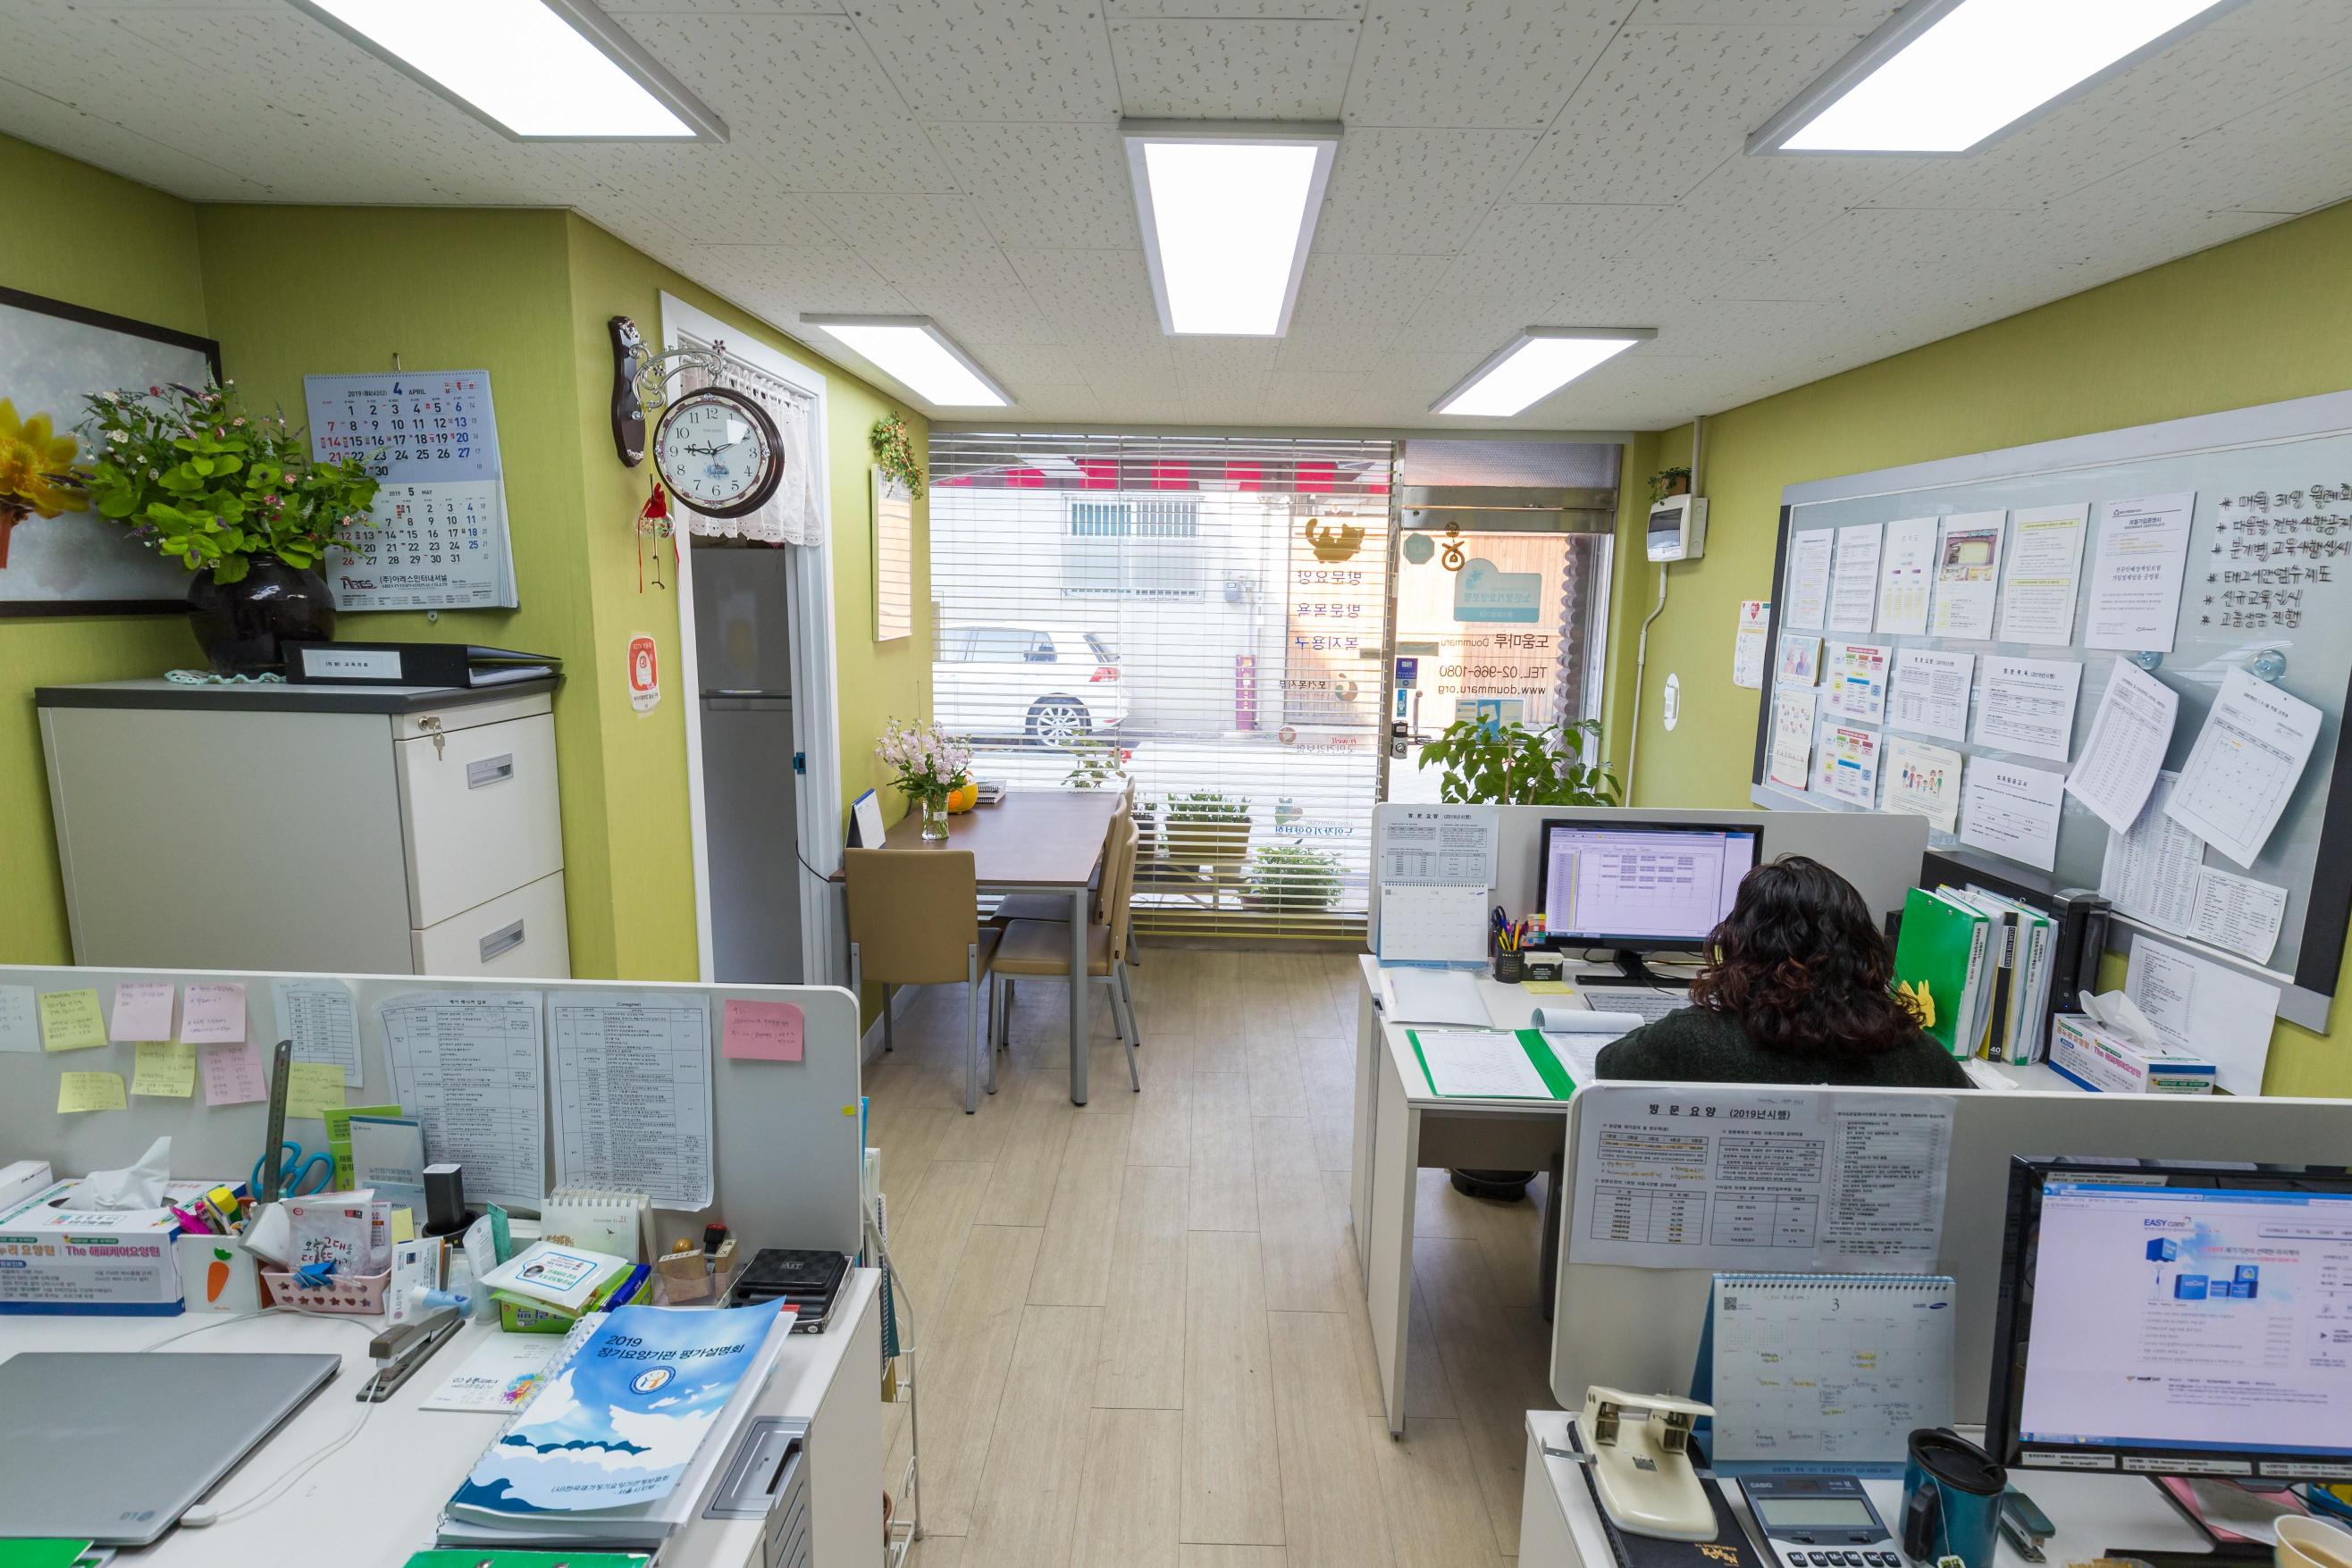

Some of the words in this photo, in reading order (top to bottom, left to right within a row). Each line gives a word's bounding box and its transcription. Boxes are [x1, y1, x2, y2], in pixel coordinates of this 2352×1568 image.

[393, 382, 402, 396] 4
[349, 406, 353, 415] 1
[370, 406, 377, 415] 2
[391, 405, 399, 415] 3
[413, 404, 421, 414] 4
[434, 403, 441, 413] 5
[455, 402, 463, 412] 6
[706, 407, 718, 419] 12
[690, 413, 699, 423] 11
[328, 422, 335, 432] 7
[350, 421, 357, 431] 8
[372, 421, 379, 431] 9
[391, 420, 404, 430] 10
[413, 419, 424, 429] 11
[434, 418, 447, 429] 12
[455, 417, 467, 427] 13
[676, 428, 690, 439] 10
[327, 437, 341, 448] 14
[349, 436, 363, 447] 15
[372, 436, 384, 446] 16
[393, 435, 406, 445] 17
[415, 434, 427, 444] 18
[436, 433, 449, 444] 19
[456, 432, 469, 443] 20
[329, 452, 341, 462] 21
[350, 451, 365, 462] 22
[395, 450, 408, 460] 24
[416, 449, 430, 459] 25
[437, 449, 450, 458] 26
[458, 448, 471, 457] 27
[670, 446, 678, 457] 9
[749, 448, 758, 458] 3
[375, 465, 389, 476] 30
[676, 465, 685, 475] 8
[743, 465, 752, 476] 4
[693, 480, 701, 491] 7
[711, 485, 720, 496] 6
[731, 481, 740, 491] 5
[407, 488, 415, 496] 5
[2239, 491, 2270, 513] 매월
[406, 505, 411, 514] 1
[427, 504, 433, 513] 2
[447, 503, 453, 512] 3
[467, 502, 474, 511] 4
[385, 518, 391, 527] 7
[407, 517, 414, 526] 8
[428, 516, 434, 525] 9
[447, 516, 458, 524] 10
[466, 516, 476, 524] 11
[2233, 516, 2270, 536] 다음달
[340, 532, 352, 541] 12
[363, 531, 374, 540] 13
[384, 531, 397, 540] 14
[407, 530, 418, 539] 15
[427, 529, 439, 538] 16
[449, 529, 458, 537] 17
[467, 528, 478, 537] 18
[364, 544, 376, 553] 20
[386, 543, 397, 552] 21
[407, 542, 420, 551] 22
[429, 542, 441, 551] 23
[449, 541, 460, 550] 24
[468, 541, 479, 549] 25
[342, 557, 355, 566] 26
[388, 556, 399, 565] 28
[409, 555, 421, 564] 29
[430, 555, 441, 564] 30
[450, 554, 460, 563] 31
[2272, 608, 2302, 628] 진행
[1729, 1109, 1790, 1120] (2019년시행)
[2145, 1219, 2168, 1227] EASY
[21, 1245, 55, 1256] 요양원
[65, 1245, 87, 1256] The
[1832, 1297, 1840, 1312] 3
[606, 1335, 643, 1347] 2019
[597, 1347, 676, 1361] 장기요양기관
[679, 1344, 745, 1360] 평가설명회
[1869, 1554, 1881, 1562] MC
